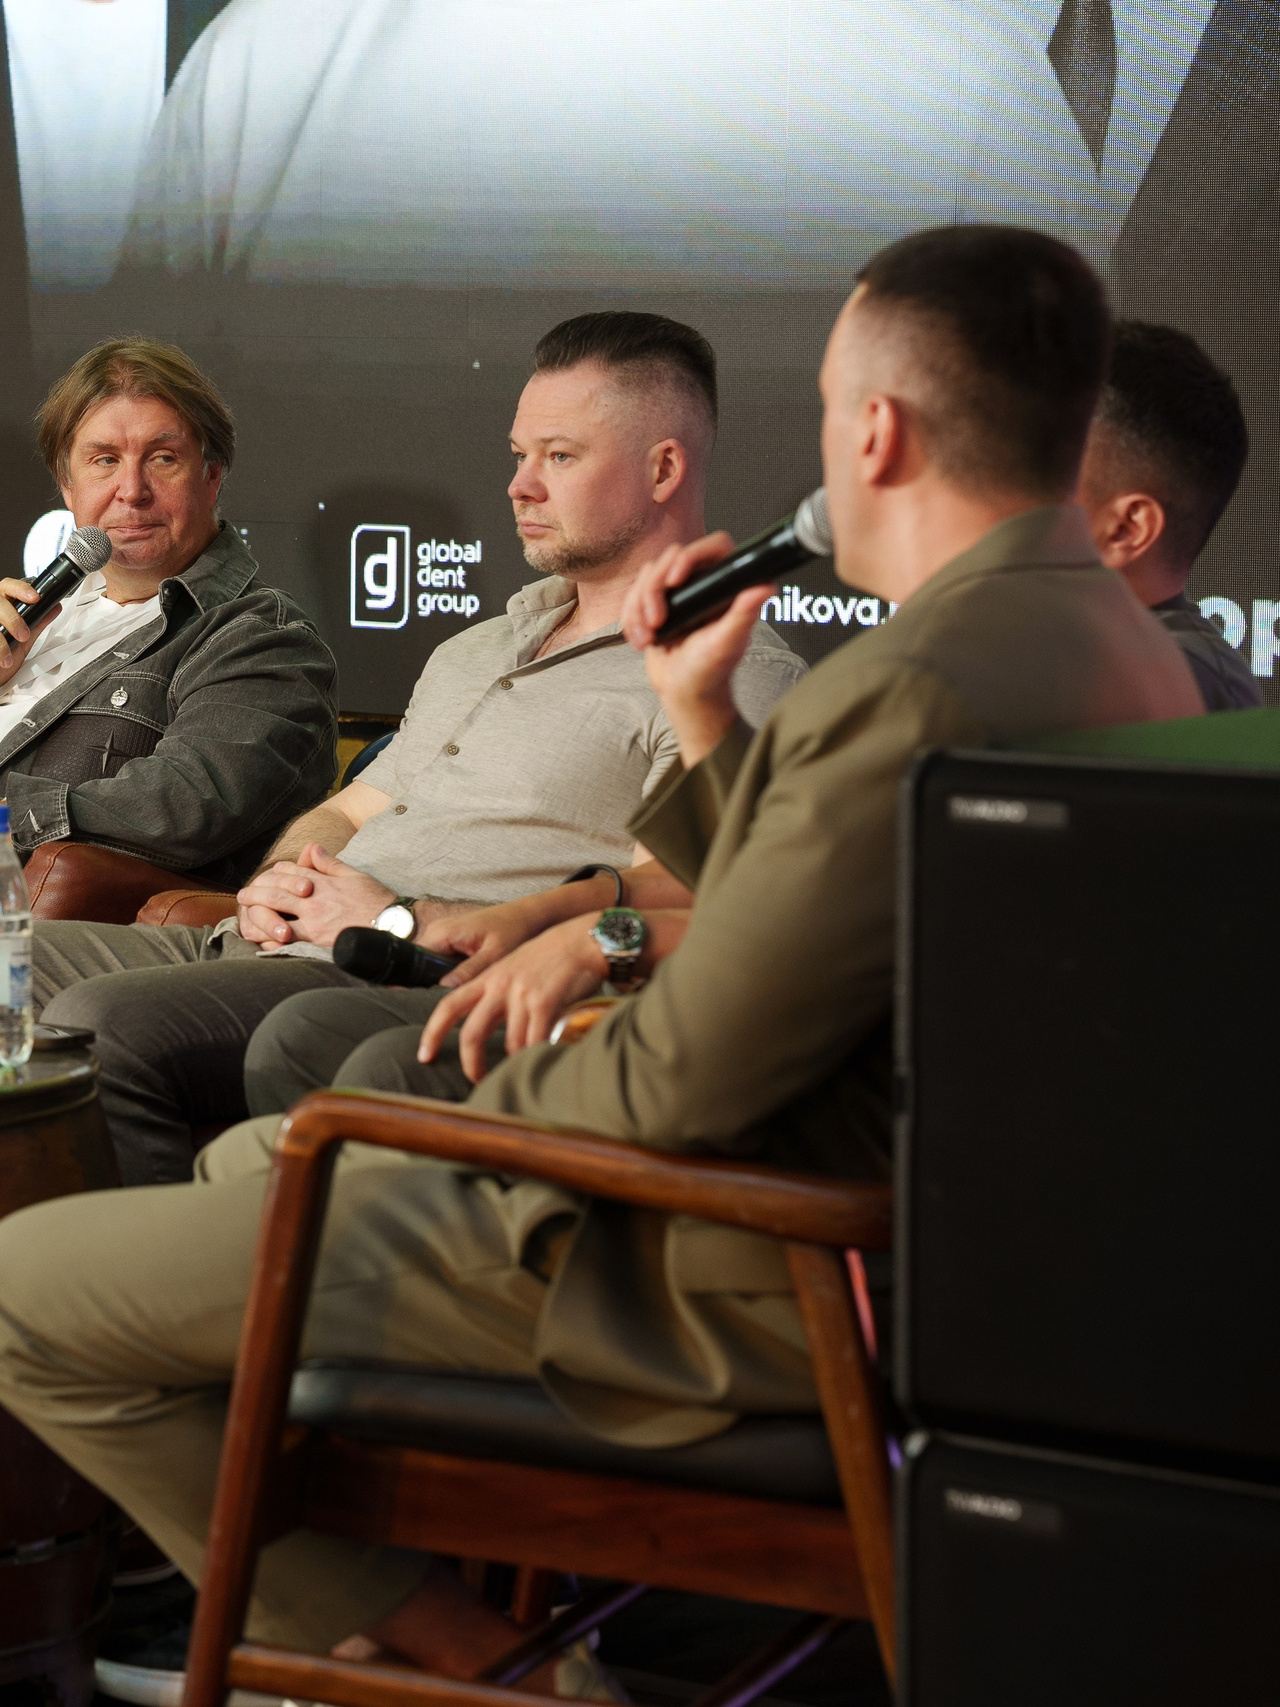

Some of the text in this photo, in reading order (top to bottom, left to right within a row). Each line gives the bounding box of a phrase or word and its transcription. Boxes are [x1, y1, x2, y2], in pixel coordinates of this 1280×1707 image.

[417, 538, 482, 566] global
[417, 565, 467, 588] dent
[417, 592, 480, 618] group
